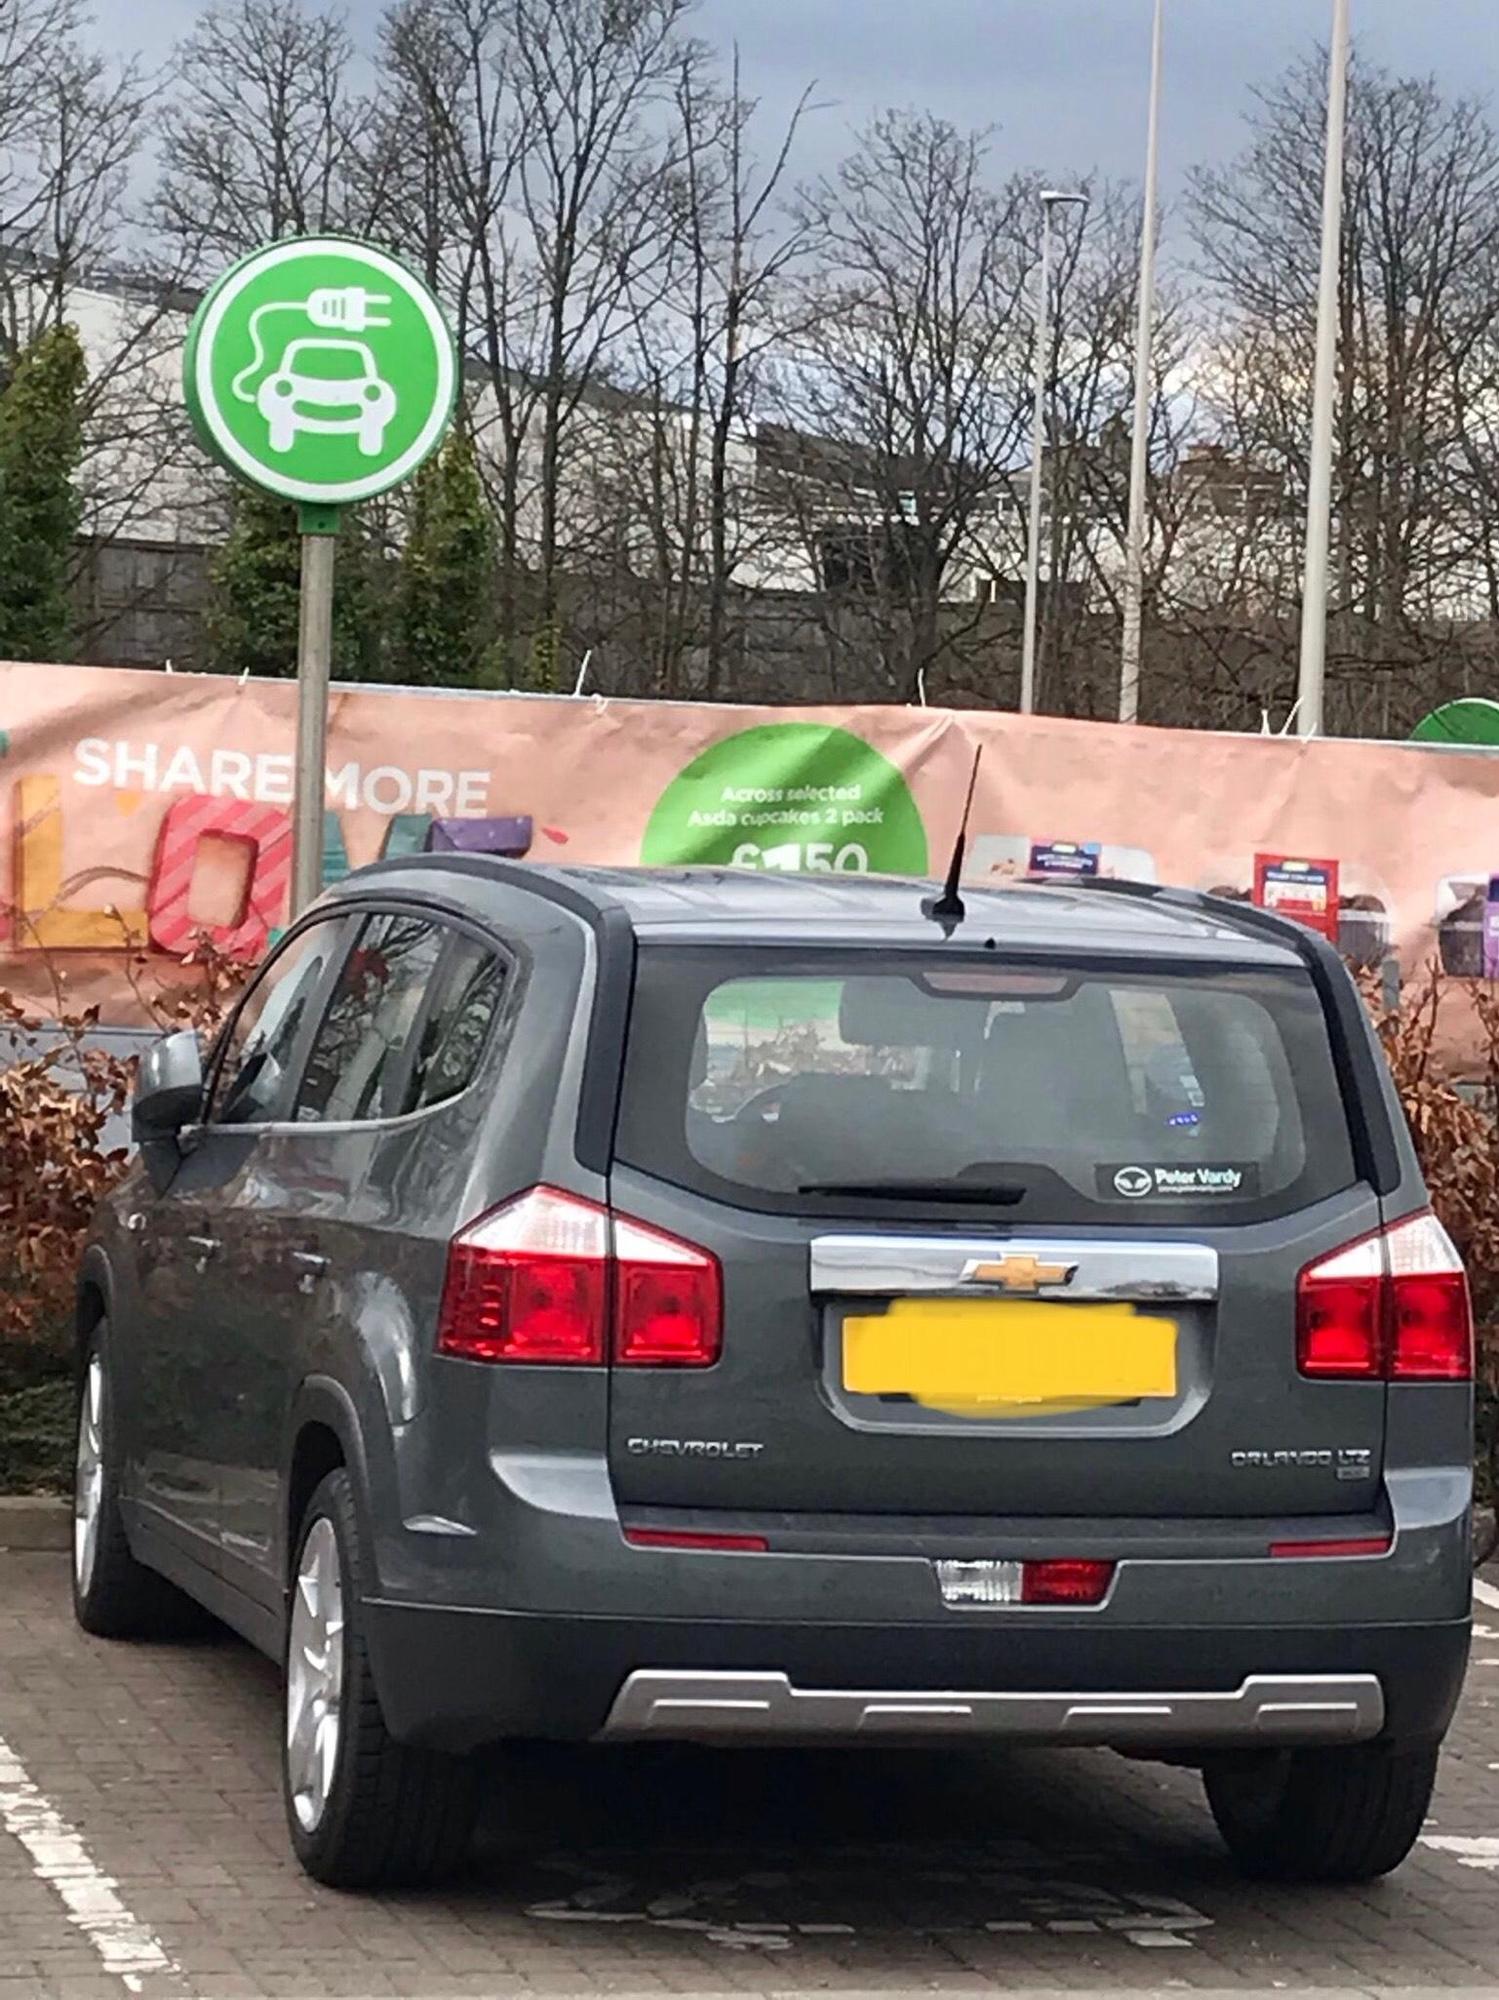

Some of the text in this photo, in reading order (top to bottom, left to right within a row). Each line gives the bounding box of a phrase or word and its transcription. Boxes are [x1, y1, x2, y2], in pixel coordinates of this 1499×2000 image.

[72, 737, 490, 818] SHARE MORE
[721, 784, 862, 802] Across selected
[688, 808, 885, 827] Asda cupcakes 2 pack
[1154, 1167, 1242, 1188] Peter Vardy
[627, 1437, 764, 1459] CHEVROLET
